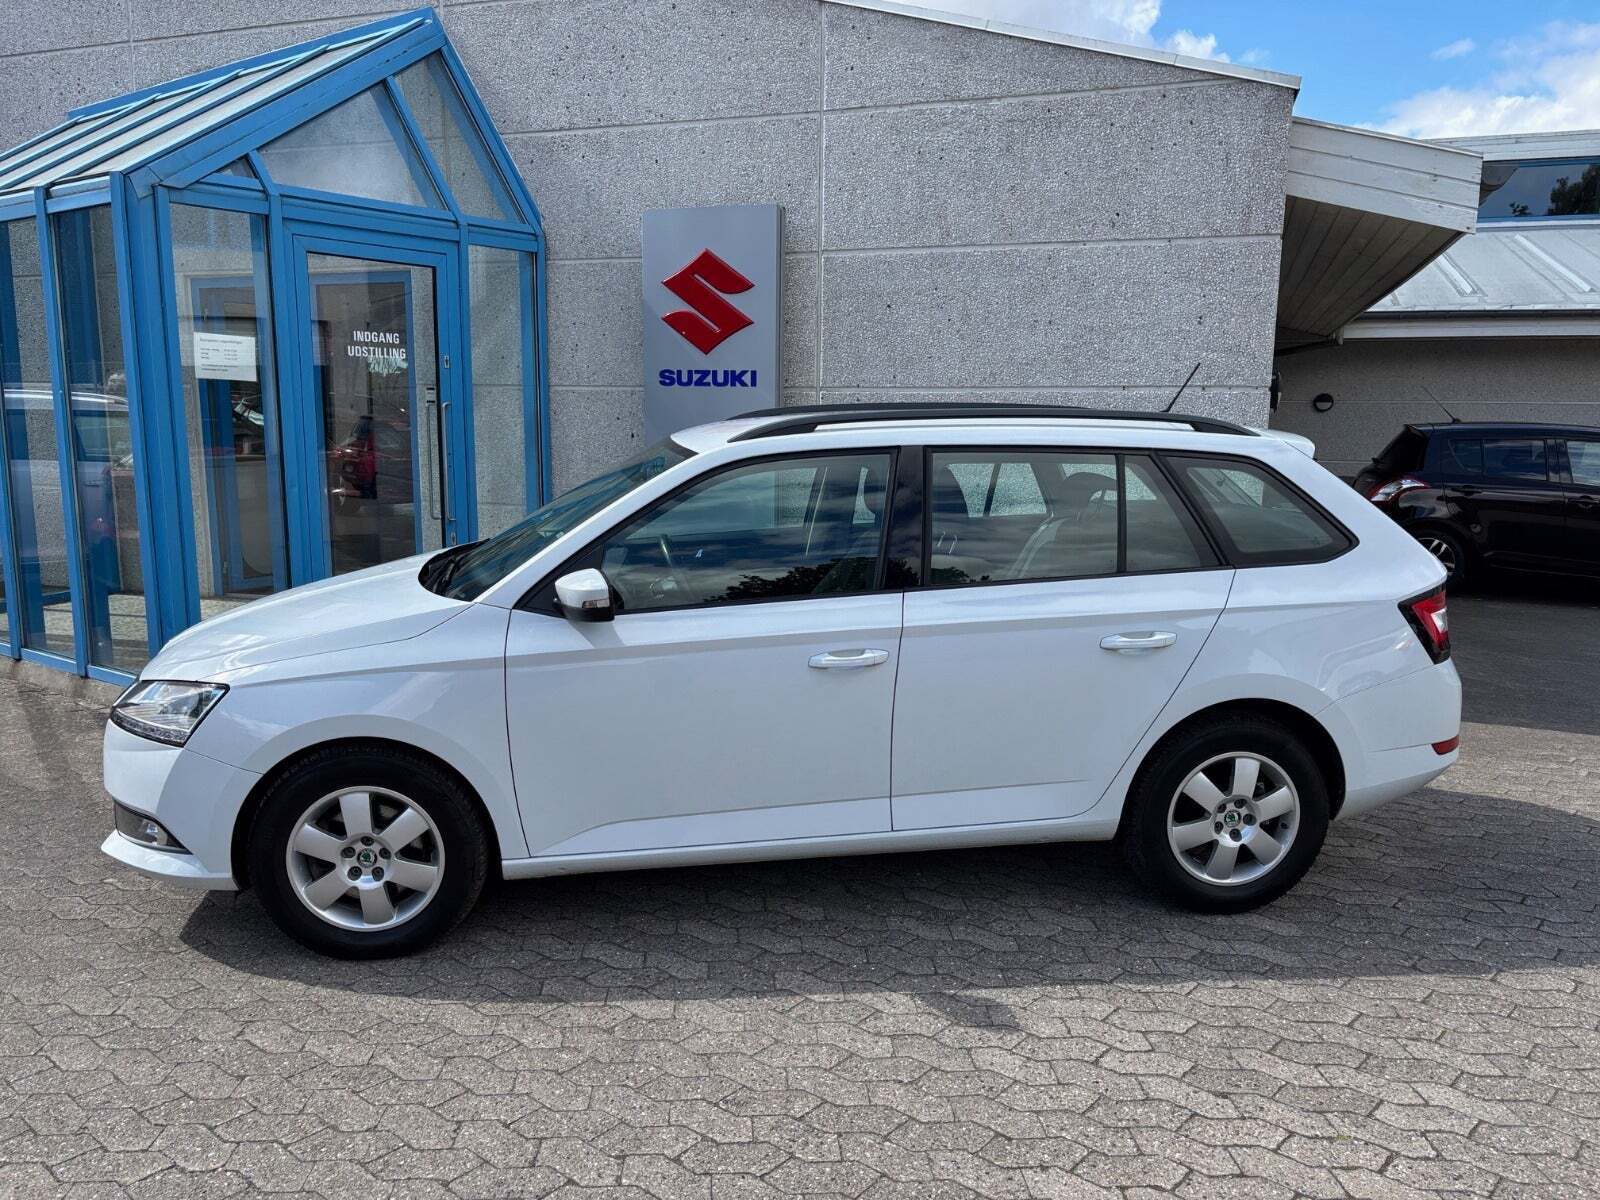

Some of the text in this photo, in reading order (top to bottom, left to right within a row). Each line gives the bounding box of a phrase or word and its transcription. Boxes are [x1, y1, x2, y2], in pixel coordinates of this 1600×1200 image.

[353, 330, 400, 344] INDGANG
[347, 345, 406, 360] UDSTILLING
[659, 369, 757, 387] SUZUKI
